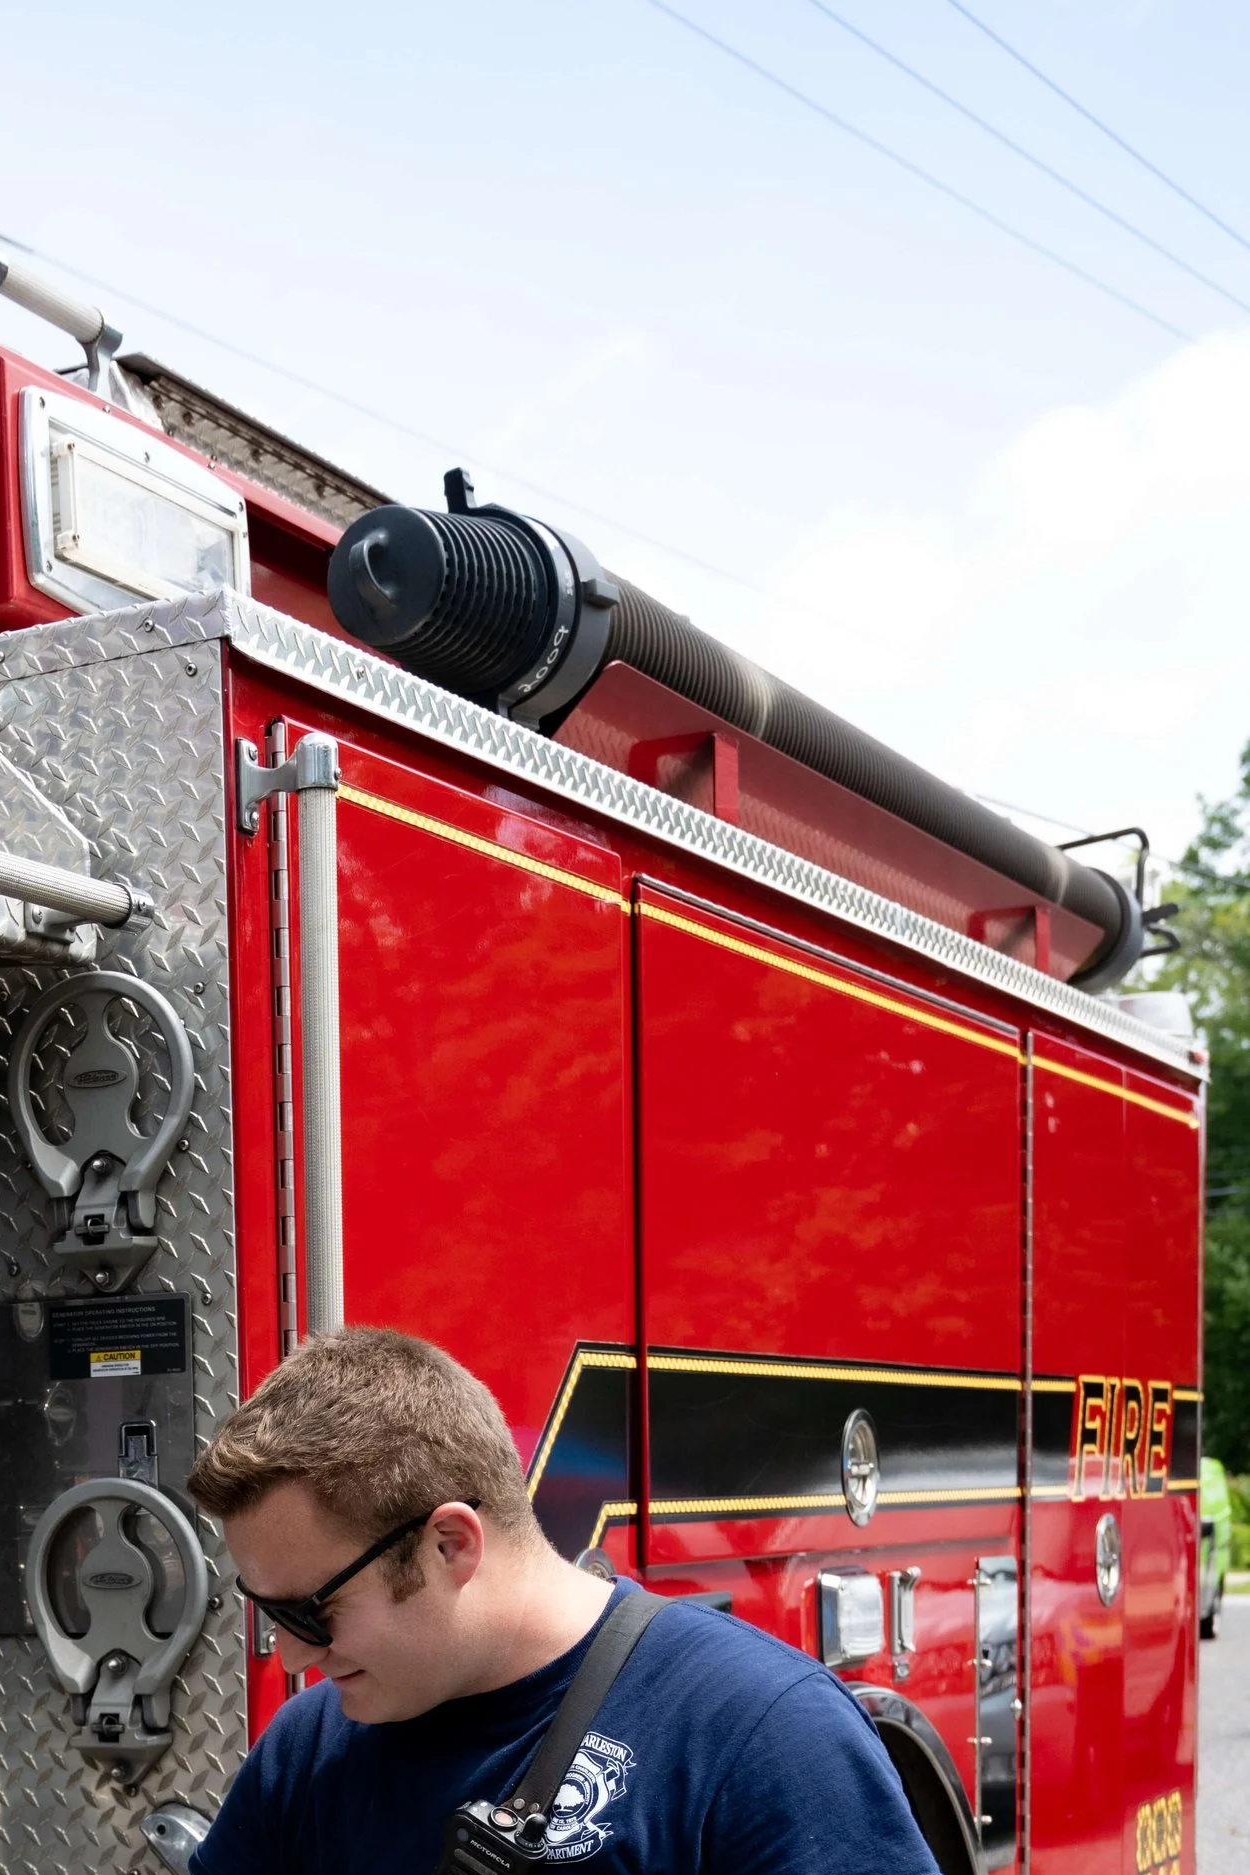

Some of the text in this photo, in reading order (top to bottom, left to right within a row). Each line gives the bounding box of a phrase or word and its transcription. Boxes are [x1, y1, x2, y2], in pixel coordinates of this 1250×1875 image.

[52, 1306, 156, 1318] GENERATOR OPERATING INSTRUCTIONS
[103, 1353, 135, 1361] CAUTION
[1071, 1375, 1171, 1502] FIRE
[470, 1839, 511, 1869] MOTOROLA
